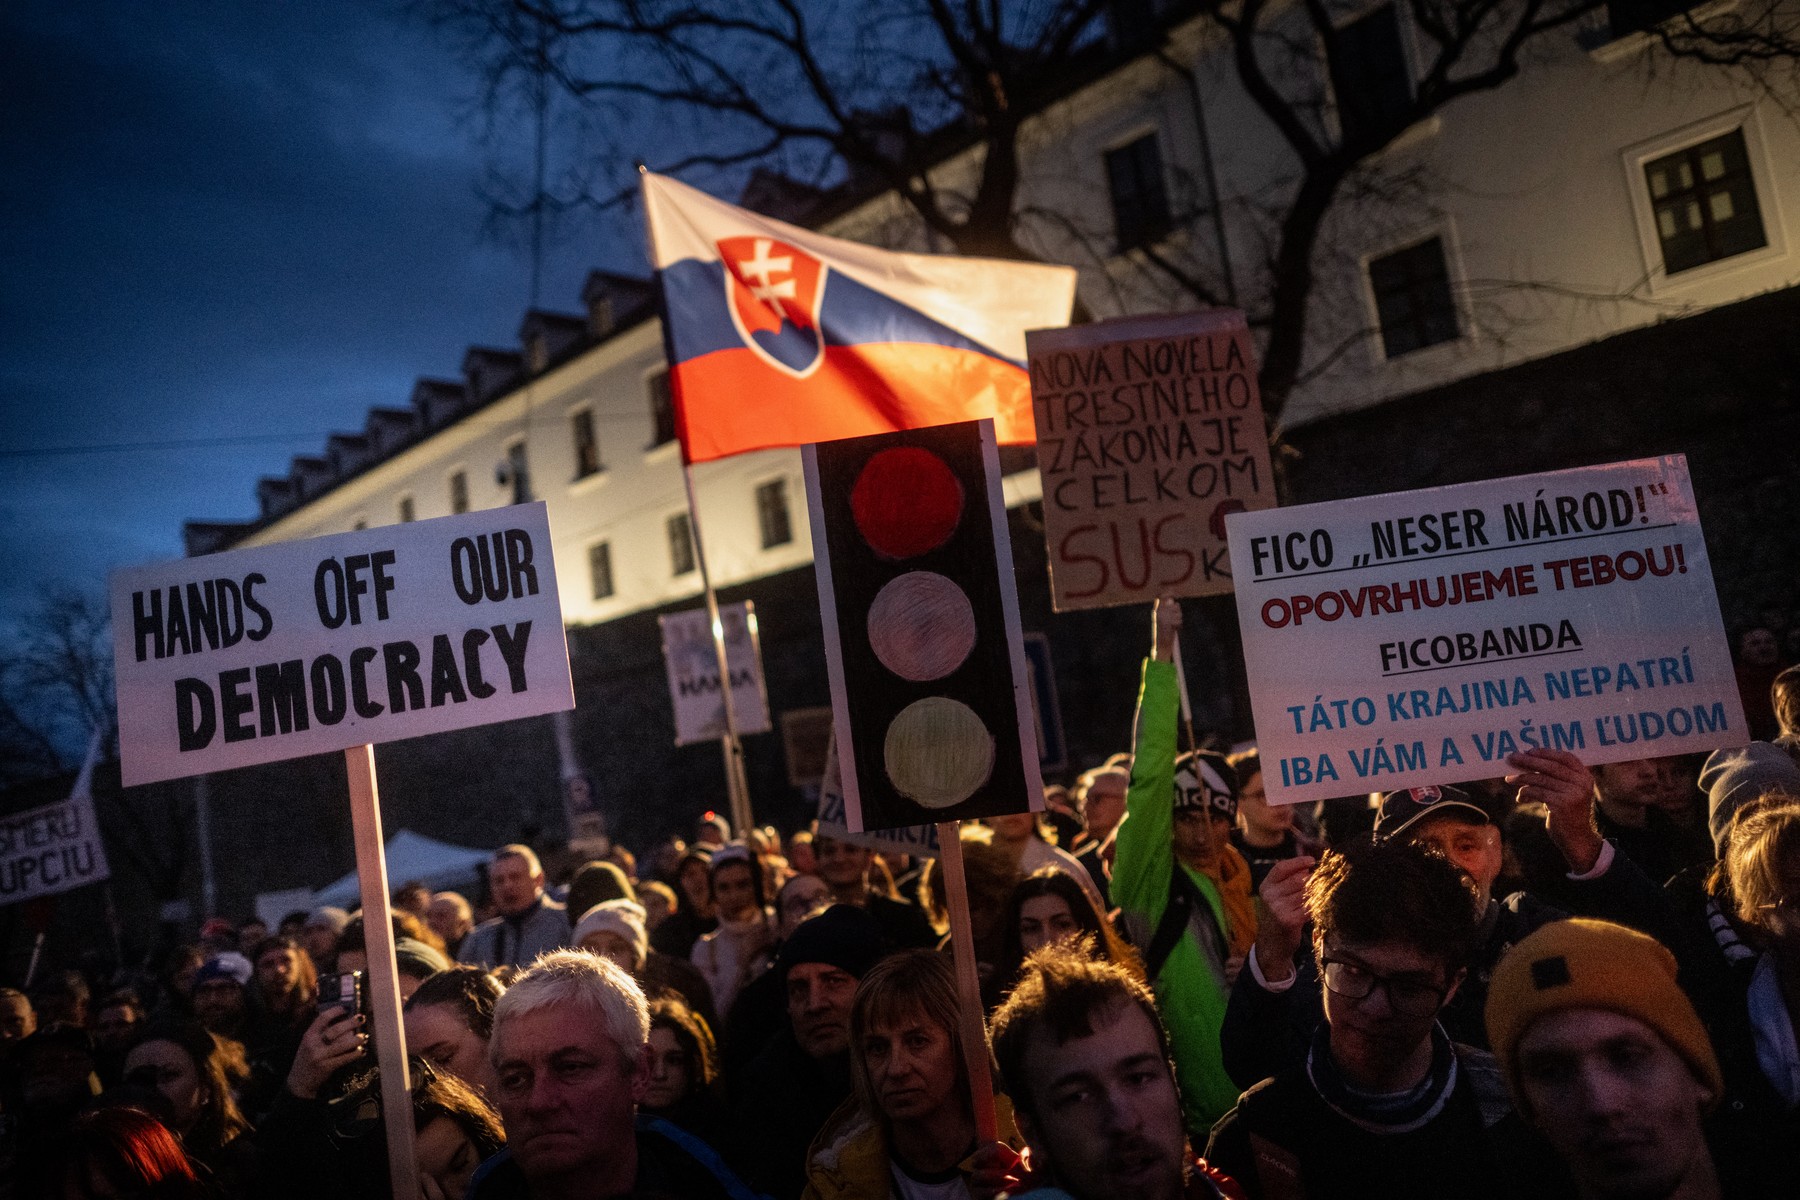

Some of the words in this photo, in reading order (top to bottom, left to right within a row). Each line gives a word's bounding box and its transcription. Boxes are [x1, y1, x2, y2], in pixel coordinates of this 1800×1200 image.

[1033, 343, 1113, 391] NOVÁ
[1122, 336, 1246, 381] NOVELA
[1037, 371, 1250, 432] TRESTNÉHO
[1043, 420, 1198, 475] ZÁKONA
[1202, 416, 1249, 457] JE
[1054, 455, 1259, 511] CELKOM
[1250, 528, 1334, 576] FICO
[132, 572, 274, 663] HANDS
[314, 550, 397, 630] OFF
[450, 528, 540, 606] OUR
[1261, 563, 1539, 629] OPOVRHUJEME
[1543, 544, 1688, 591] TEBOU!
[1379, 619, 1582, 672] FICOBANDA
[174, 619, 533, 752] DEMOCRACY
[1287, 694, 1377, 735] TÁTO
[1387, 676, 1536, 722] KRAJINA
[1544, 646, 1695, 701] NEPATRÍ
[1280, 753, 1340, 787] IBA
[1348, 737, 1428, 778] VÁM
[1439, 737, 1465, 767] A
[1471, 718, 1586, 761] VAŠIM
[1595, 702, 1729, 747] ĽUDOM
[1174, 787, 1237, 816] idas
